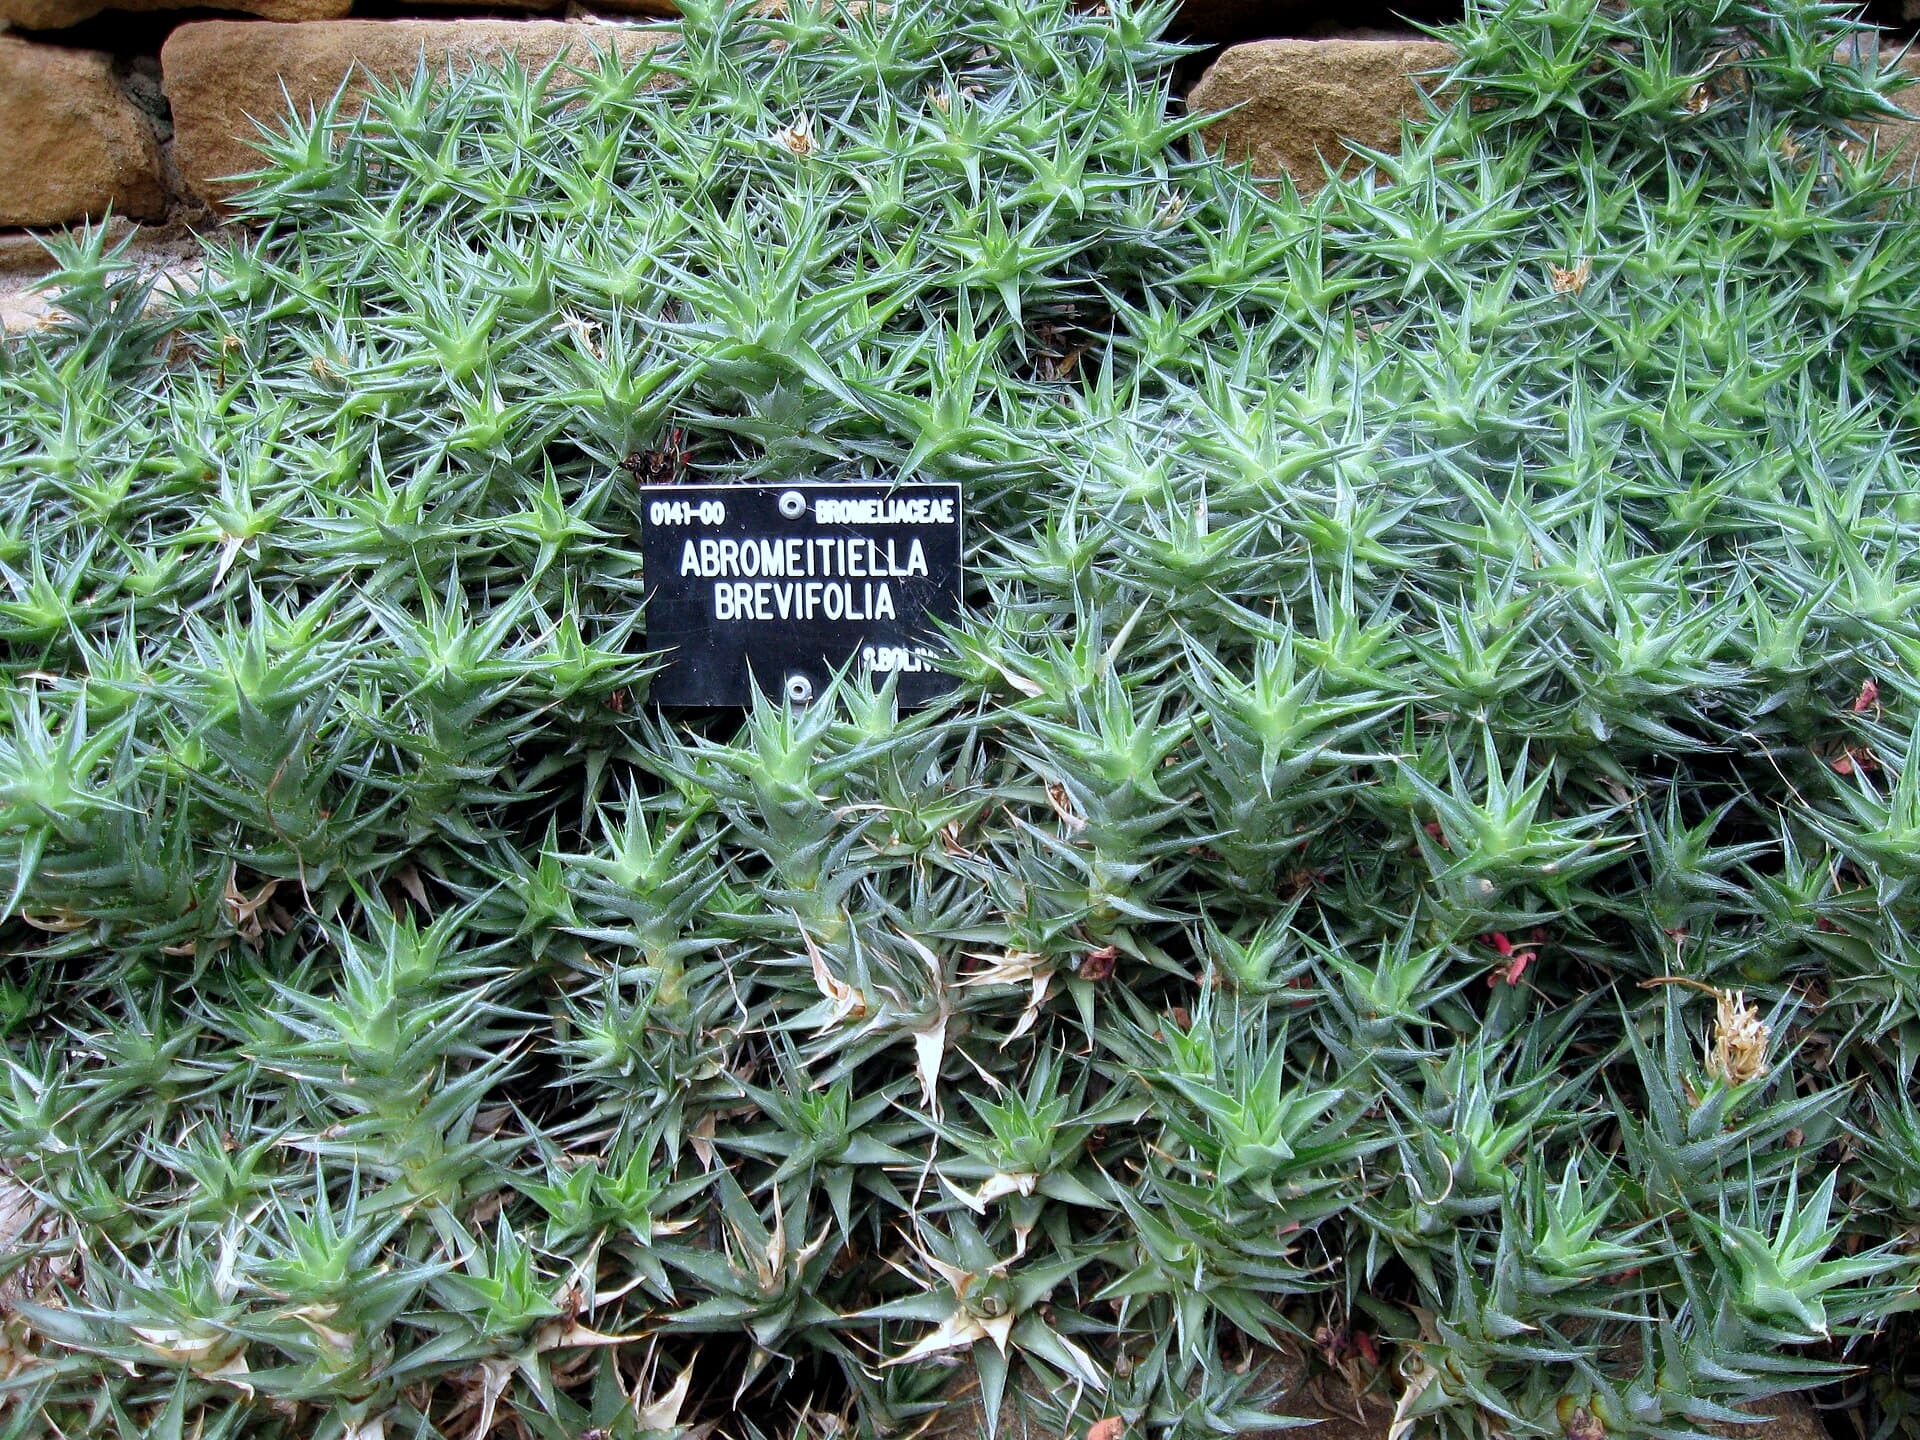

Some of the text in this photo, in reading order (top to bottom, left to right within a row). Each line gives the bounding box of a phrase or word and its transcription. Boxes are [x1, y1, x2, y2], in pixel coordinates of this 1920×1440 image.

[650, 501, 726, 526] 0141-00
[815, 499, 955, 525] BROMELIACEAE
[680, 538, 929, 578] ABROMEITIELLA
[714, 582, 897, 621] BREVIFOLIA
[862, 646, 950, 673] S.BOLIV
